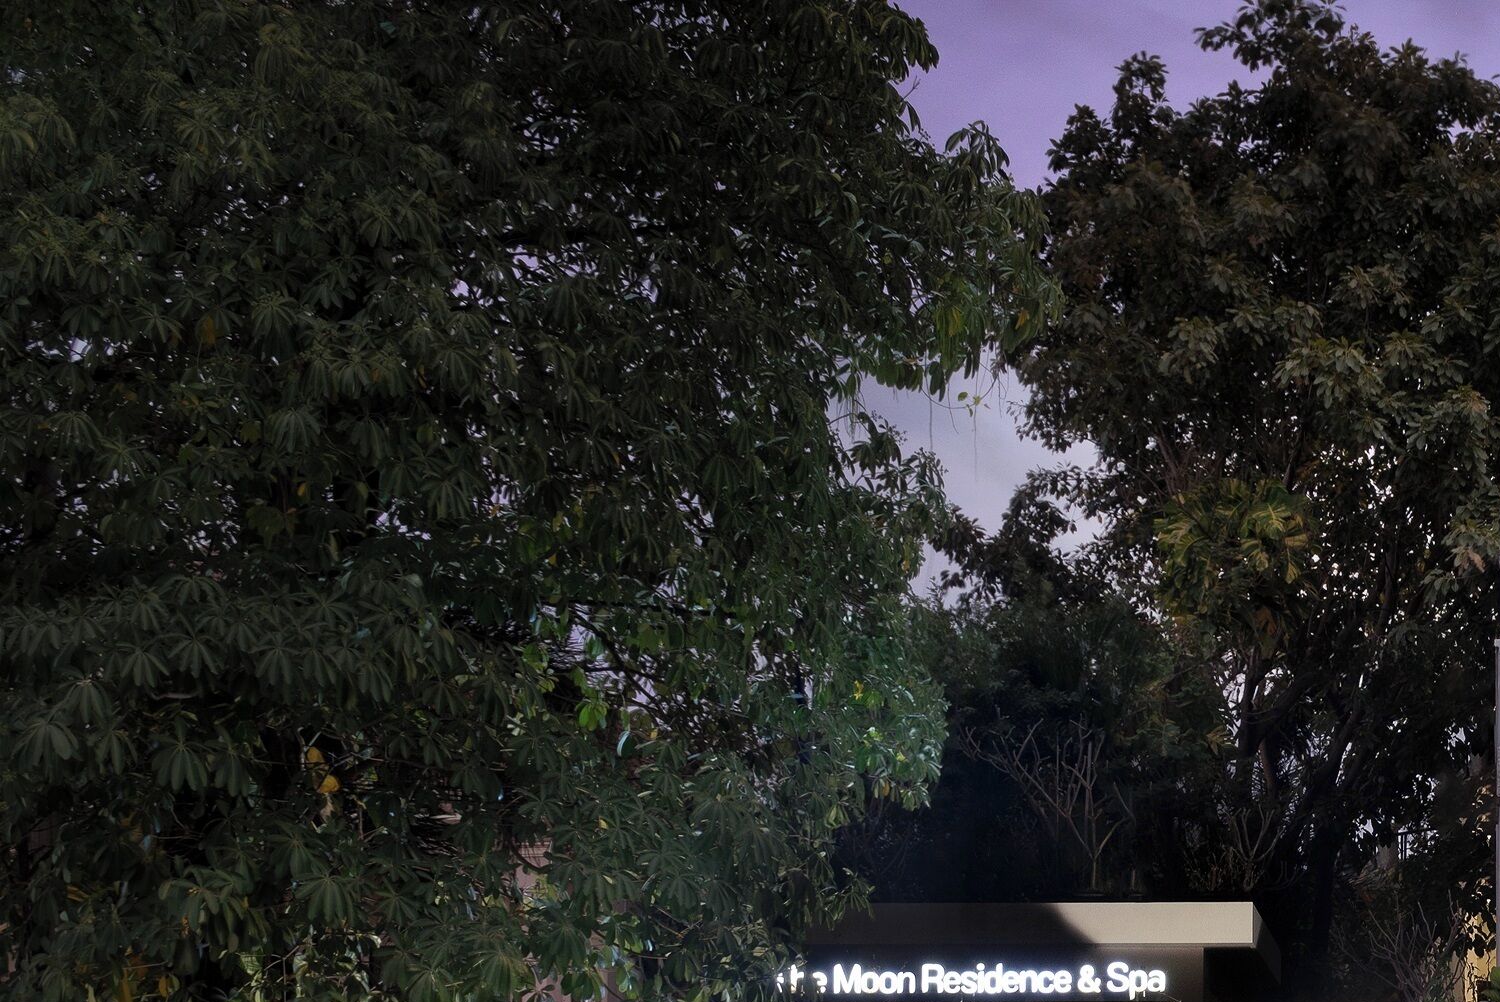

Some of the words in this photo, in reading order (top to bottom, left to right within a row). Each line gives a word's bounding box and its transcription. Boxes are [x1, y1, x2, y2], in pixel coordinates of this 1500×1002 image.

[833, 963, 916, 994] Moon
[921, 962, 1072, 994] Residence
[1077, 964, 1101, 994] &
[1106, 961, 1167, 1000] Spa
